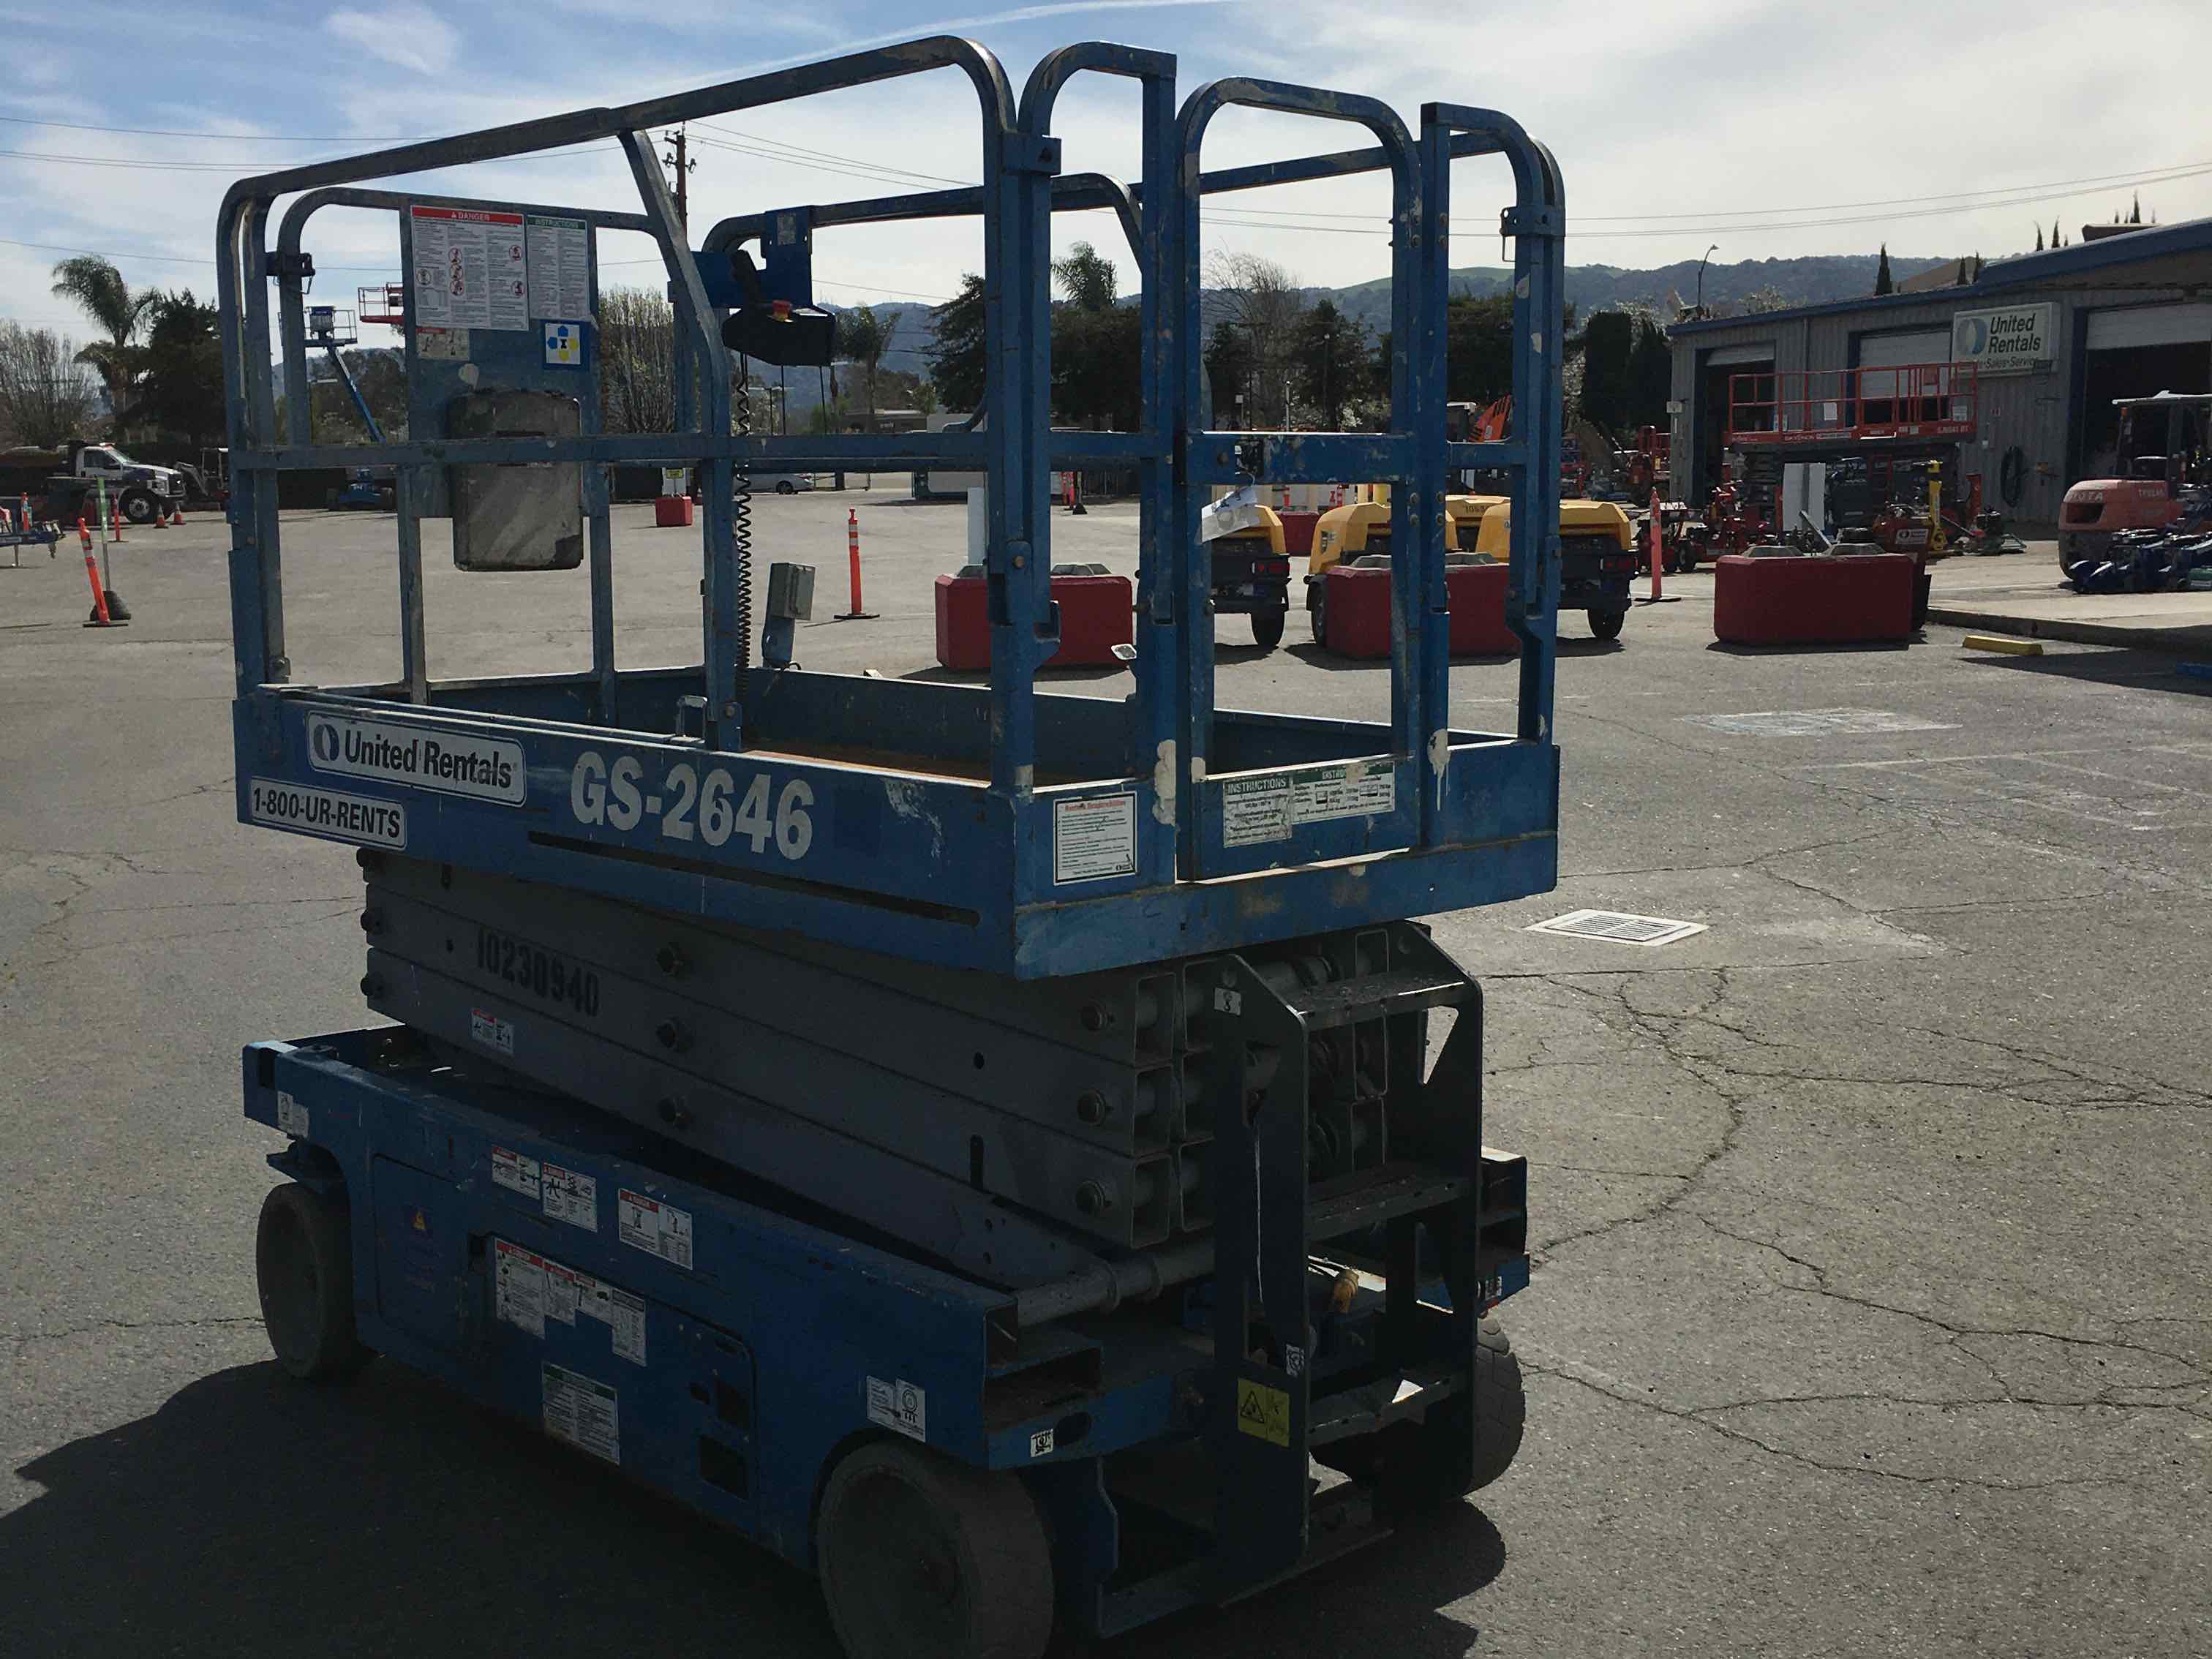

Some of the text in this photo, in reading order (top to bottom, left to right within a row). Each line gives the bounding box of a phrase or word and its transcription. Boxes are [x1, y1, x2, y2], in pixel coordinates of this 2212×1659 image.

[458, 212, 491, 221] DANGER
[1990, 313, 2036, 334] United
[1987, 334, 2042, 353] Rentals
[345, 729, 511, 789] United Rentals
[1228, 778, 1286, 794] INSTRUCTIONS
[253, 787, 401, 838] 1-800-UR-RENTS
[571, 751, 814, 861] GS-2646
[478, 925, 599, 1017] 10230940
